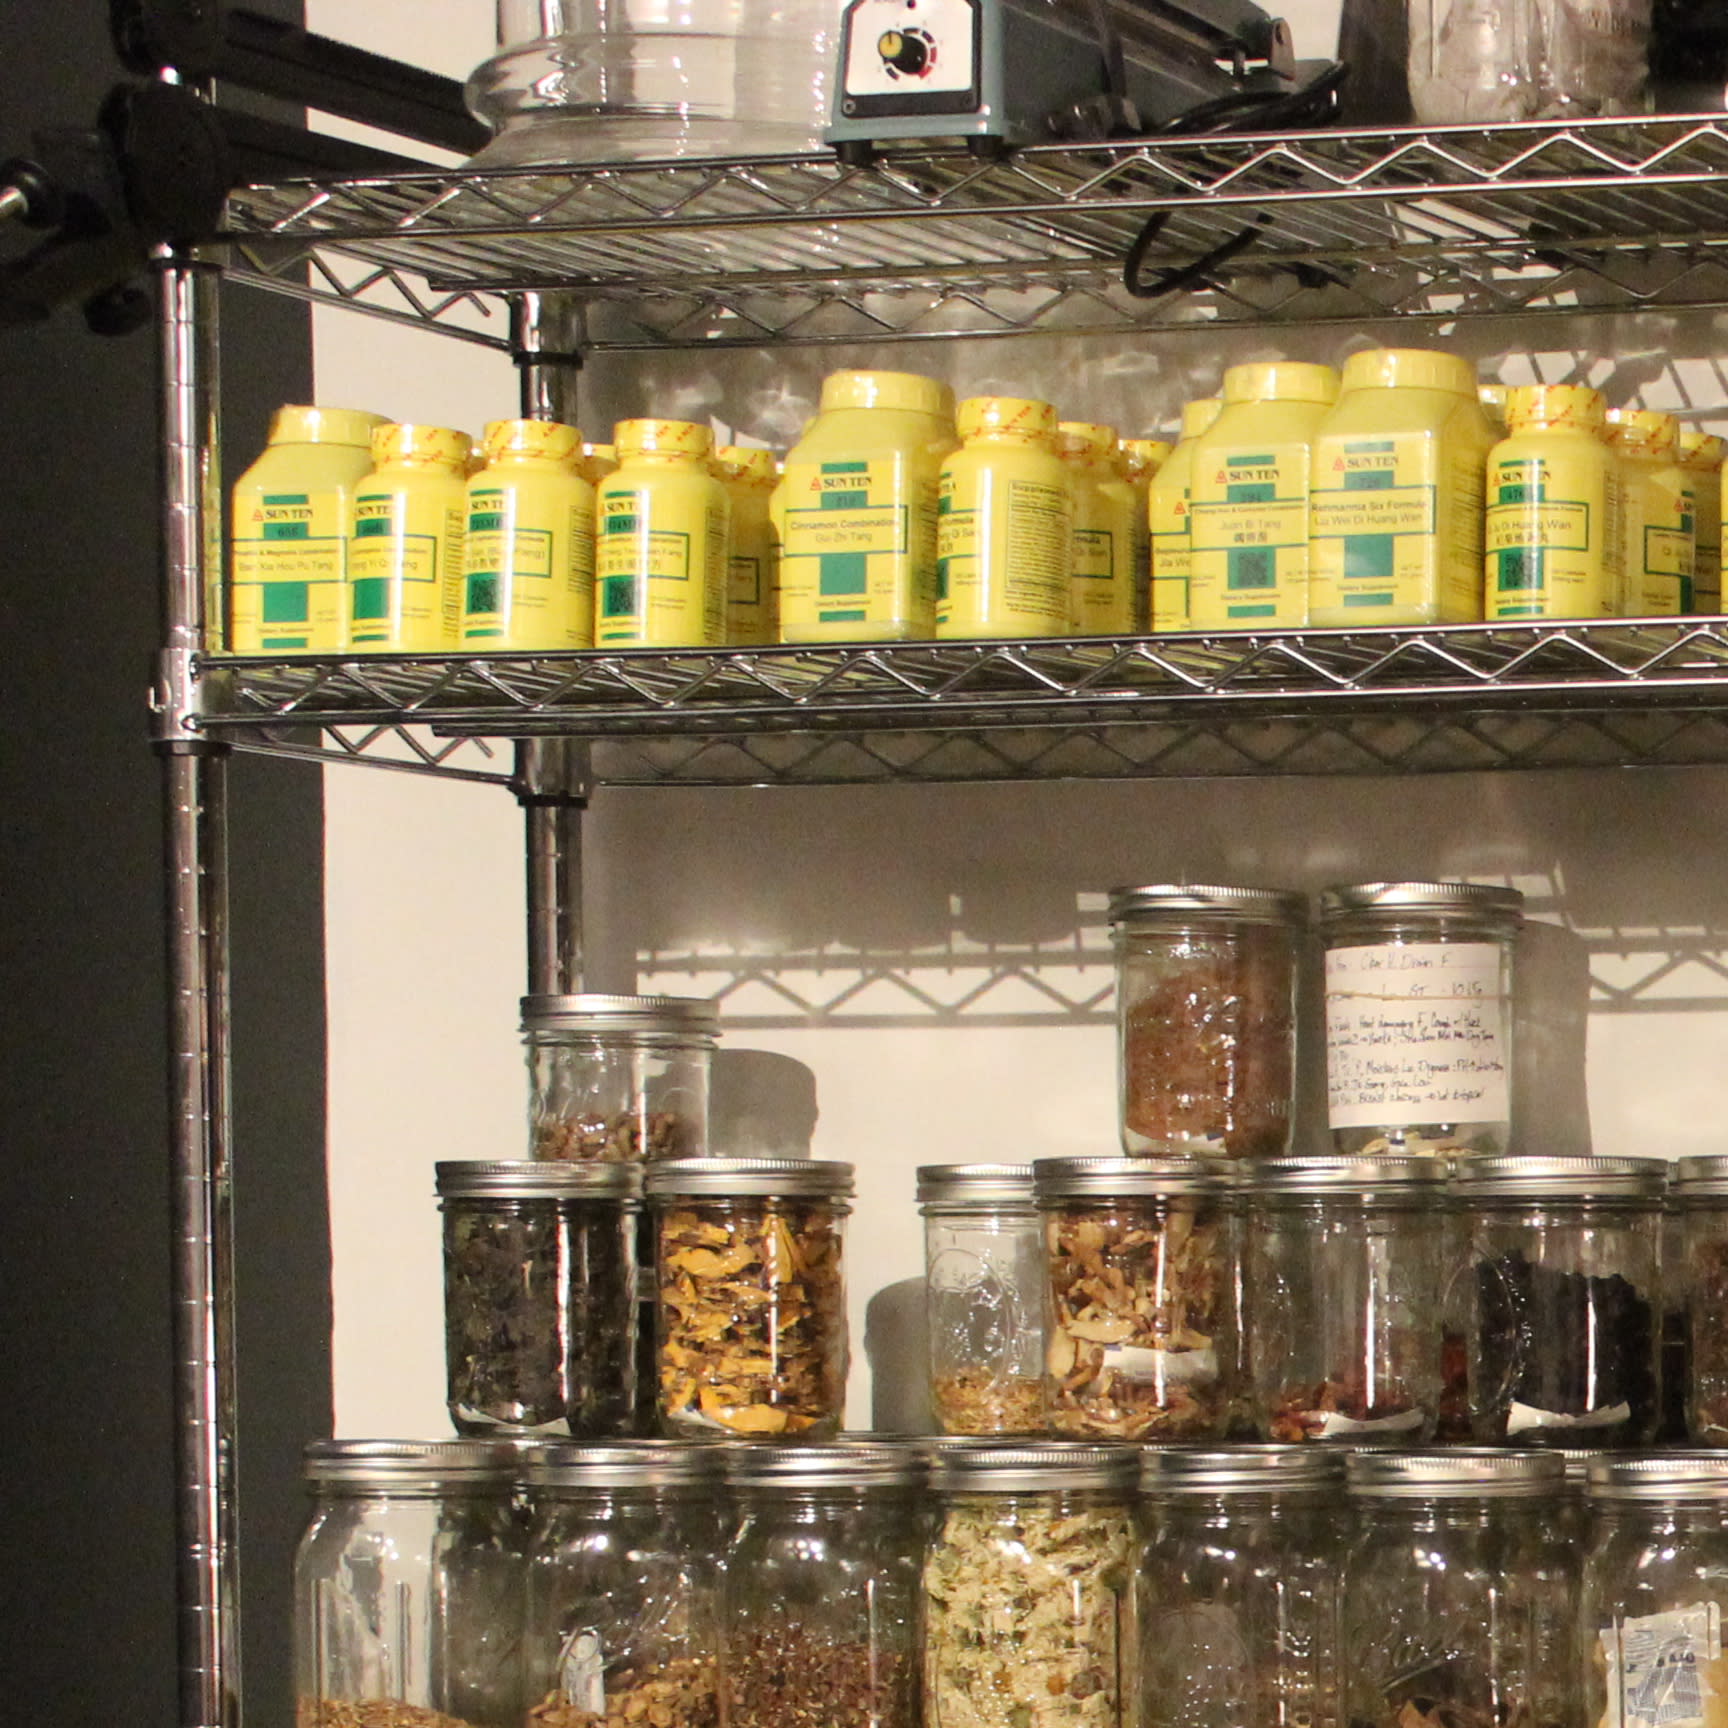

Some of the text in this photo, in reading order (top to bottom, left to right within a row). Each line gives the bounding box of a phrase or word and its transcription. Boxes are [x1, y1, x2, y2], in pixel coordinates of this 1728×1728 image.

[1347, 456, 1400, 468] SUN TEN
[1229, 469, 1280, 481] SUN TEN
[823, 476, 873, 488] SUN TEN
[266, 508, 314, 519] SUN TEN
[790, 520, 839, 531] Cinnamon
